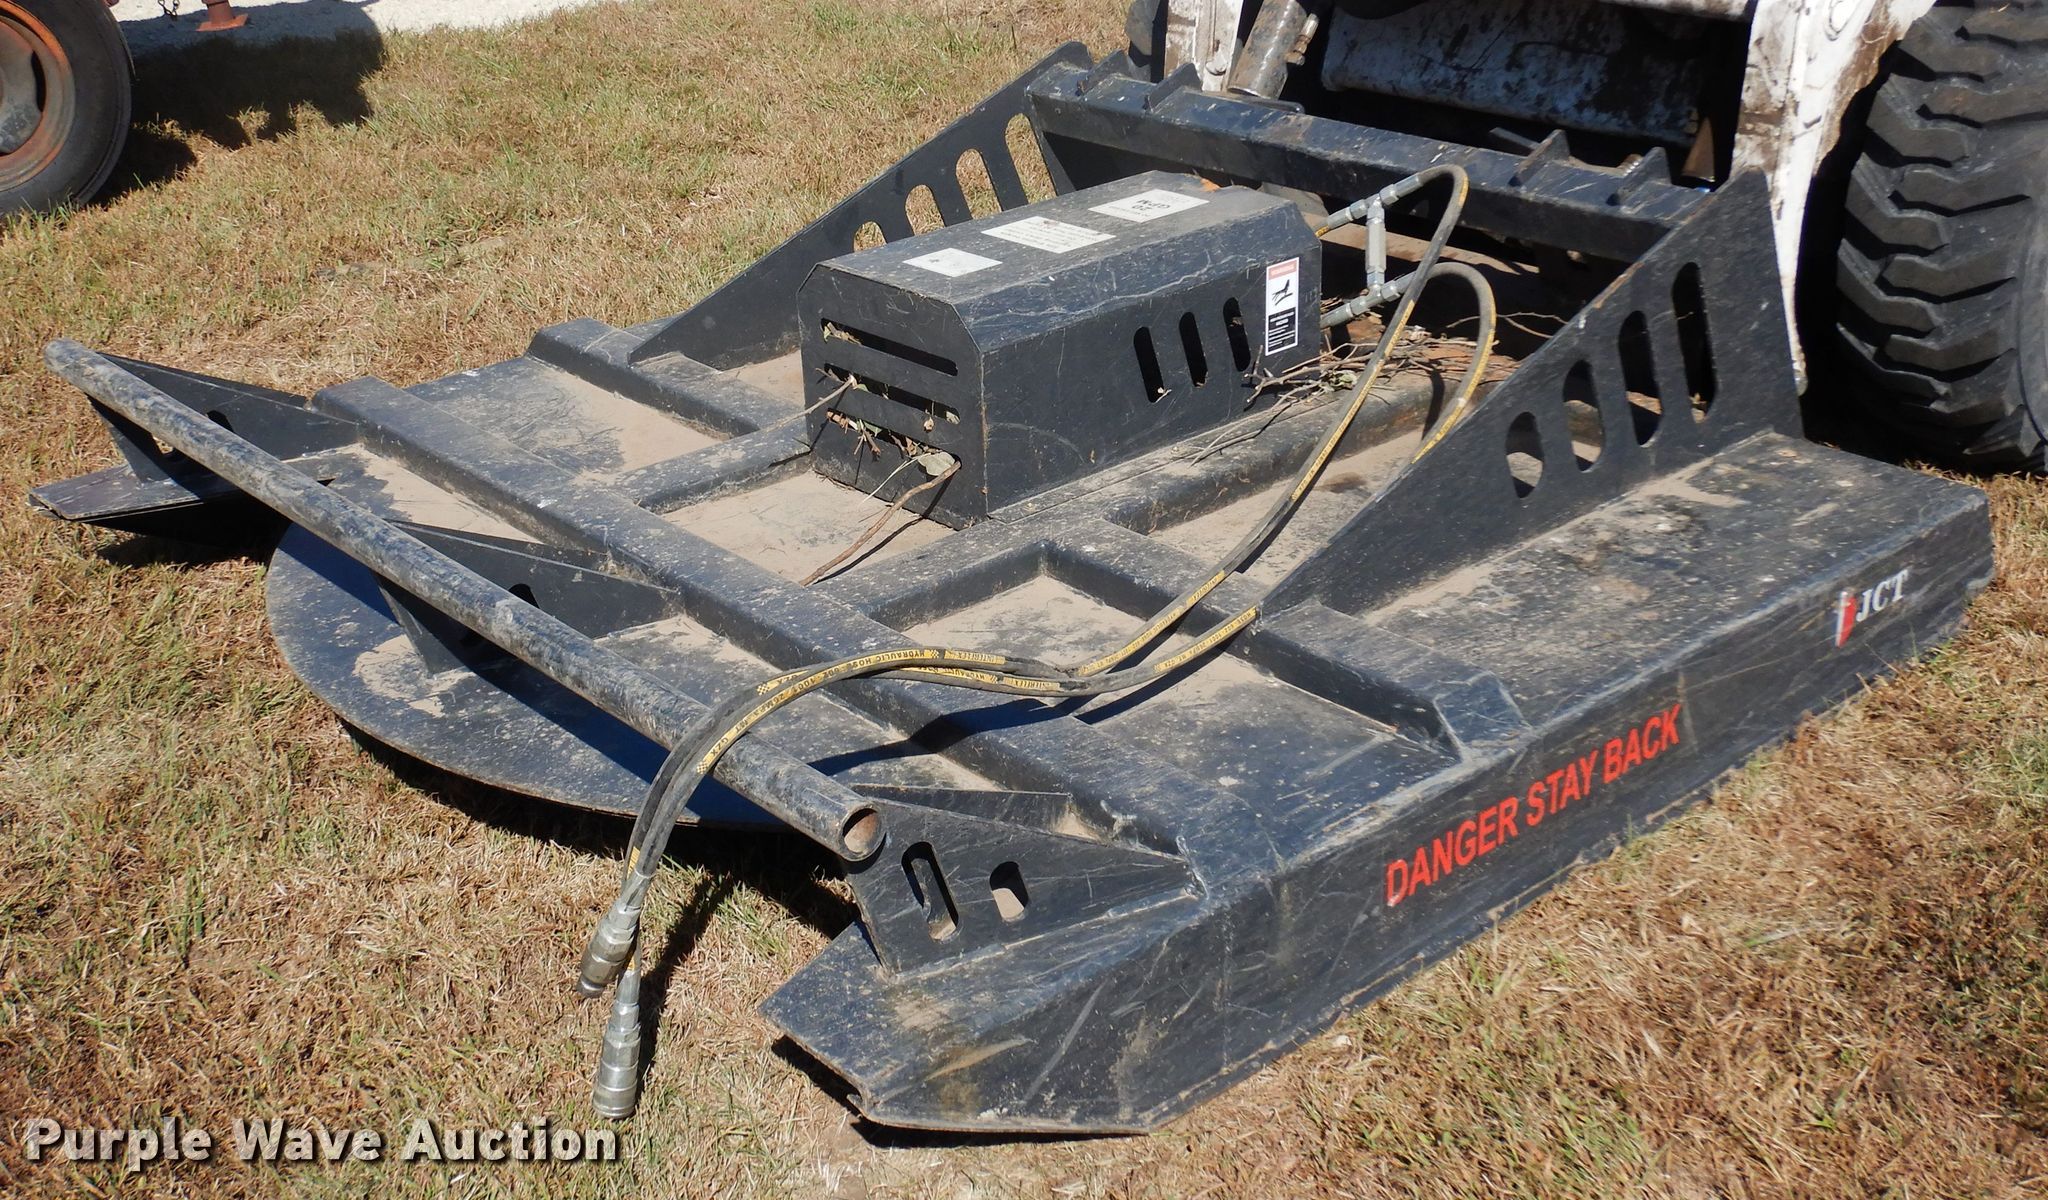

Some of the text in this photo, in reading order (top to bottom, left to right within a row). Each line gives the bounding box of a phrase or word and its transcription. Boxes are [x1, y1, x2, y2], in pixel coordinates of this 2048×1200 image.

[1856, 569, 1909, 622] JCT
[876, 650, 925, 662] HYDRAULIC
[1386, 703, 1681, 906] DANGER STAY BACK
